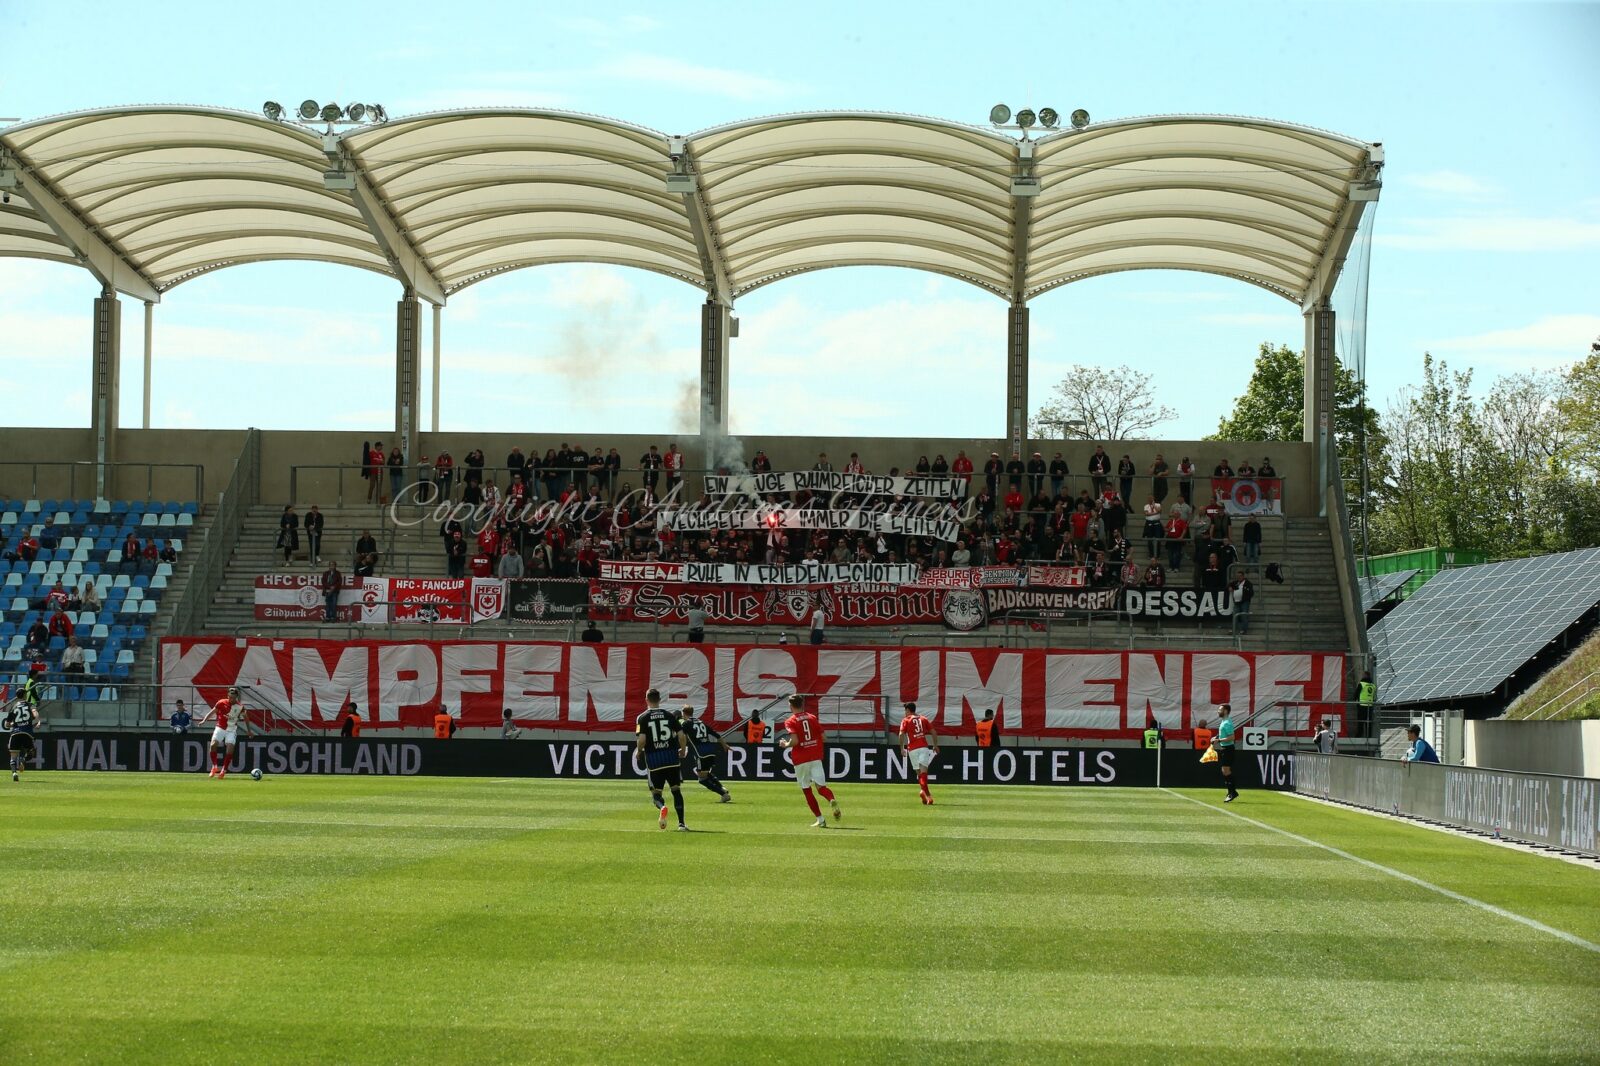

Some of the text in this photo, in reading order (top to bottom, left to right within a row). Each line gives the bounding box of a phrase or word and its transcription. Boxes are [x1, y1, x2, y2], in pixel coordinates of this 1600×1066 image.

[704, 470, 962, 497] EIN UGE RUHMREICHER ZEITEN
[659, 509, 958, 540] WECHSELT FR IMMER DIE SEITEN!
[263, 574, 354, 586] HFC CHIE
[687, 563, 724, 582] RUHE
[735, 564, 749, 582] IN
[758, 564, 833, 584] FRIEDEN,
[396, 580, 415, 590] HFC
[422, 580, 464, 590] FANCLUB
[477, 586, 500, 594] HFC
[634, 584, 760, 622] Saale
[987, 587, 1120, 614] BADKURVEN-CREW
[1126, 589, 1234, 617] DESSAU
[264, 607, 307, 619] Südpark
[161, 637, 1343, 733] KÄMPFEN BIS ZUM ENDE!
[13, 705, 31, 723] 25
[647, 719, 672, 742] 15
[692, 721, 708, 739] 29
[802, 719, 812, 741] 9
[912, 718, 924, 734] 31
[1245, 732, 1266, 746] C3
[56, 738, 128, 771] MAL
[139, 739, 175, 771] IN
